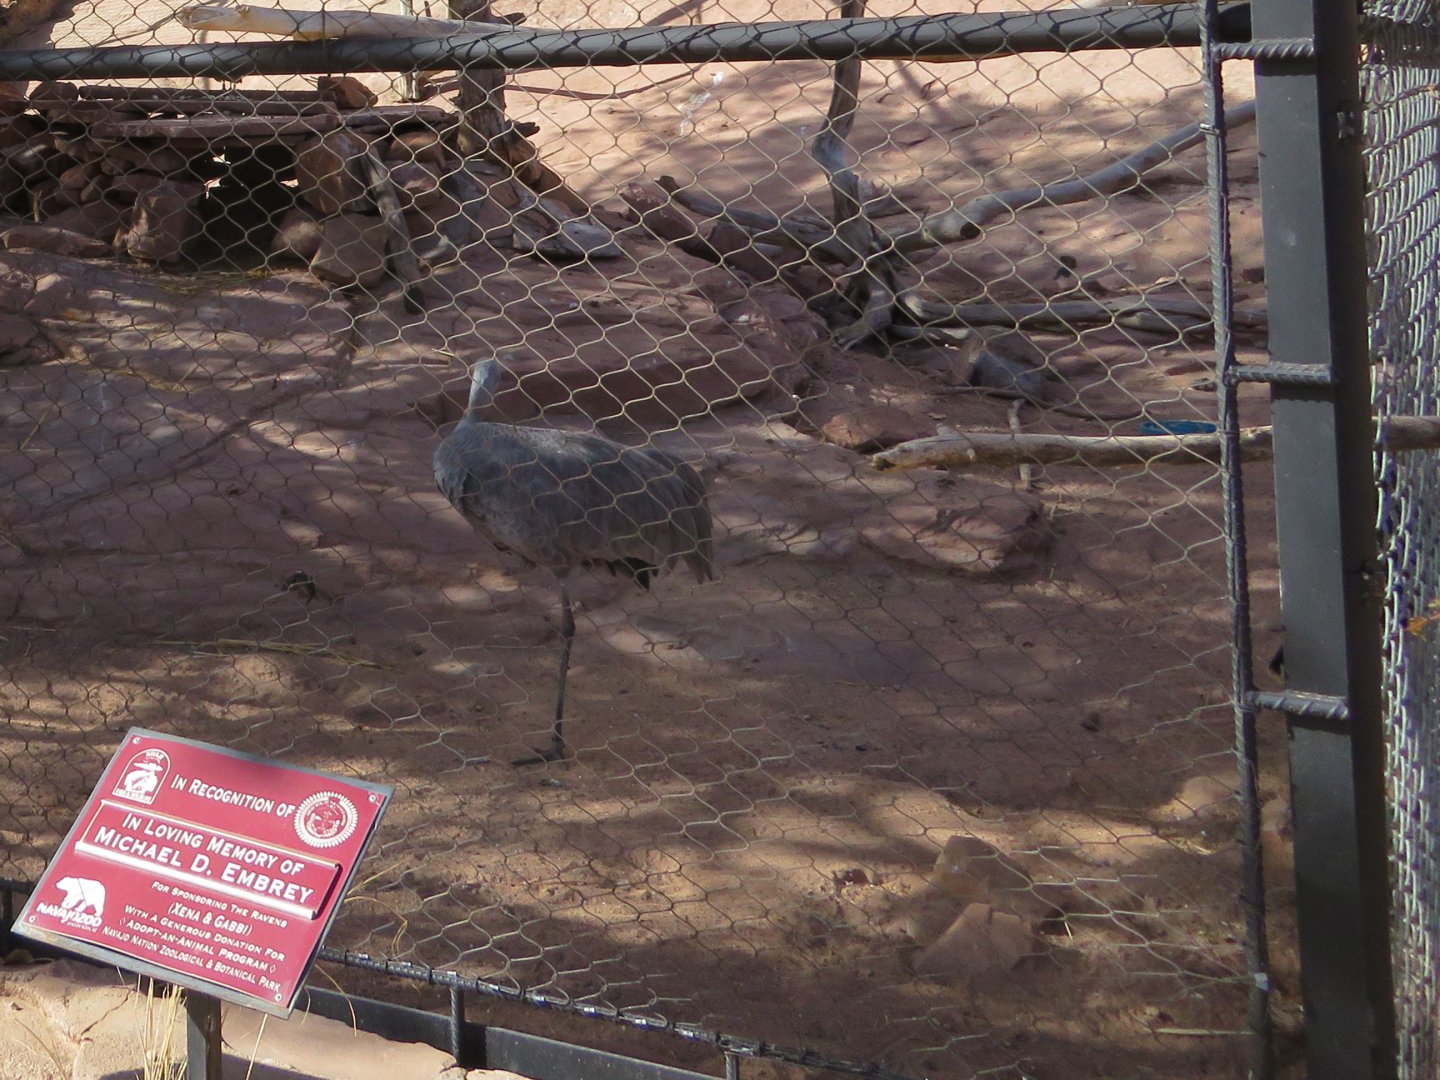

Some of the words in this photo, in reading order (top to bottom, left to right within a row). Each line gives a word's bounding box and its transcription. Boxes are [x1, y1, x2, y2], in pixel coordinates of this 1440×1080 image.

[171, 774, 187, 791] IN
[189, 779, 275, 813] RECOGNITION
[276, 802, 296, 817] OF
[94, 826, 182, 867] MICHAEL
[190, 854, 211, 876] D.
[221, 863, 315, 903] EMBREY
[122, 813, 142, 831] IN
[144, 819, 204, 848] LOVING
[206, 836, 279, 869] MEMORY
[280, 859, 305, 876] OF
[152, 881, 169, 893] FOR
[171, 887, 227, 910] SPONSORING
[230, 904, 249, 917] THE
[251, 910, 288, 928] RAVENS
[168, 902, 200, 922] (XENA
[202, 912, 213, 925] &
[214, 915, 253, 936] GABBI)
[124, 905, 148, 919] WITH
[150, 914, 158, 923] A
[160, 918, 211, 939] GENEROUS
[213, 933, 262, 954] DONATION
[264, 948, 286, 961] FOR
[102, 926, 130, 942] NAVAJO
[131, 936, 159, 952] NATION
[159, 945, 204, 967] ZOOLOGICAL
[213, 962, 257, 984] BOTANICAL
[258, 975, 281, 993] PARK
[218, 948, 268, 971] PROGRAM
